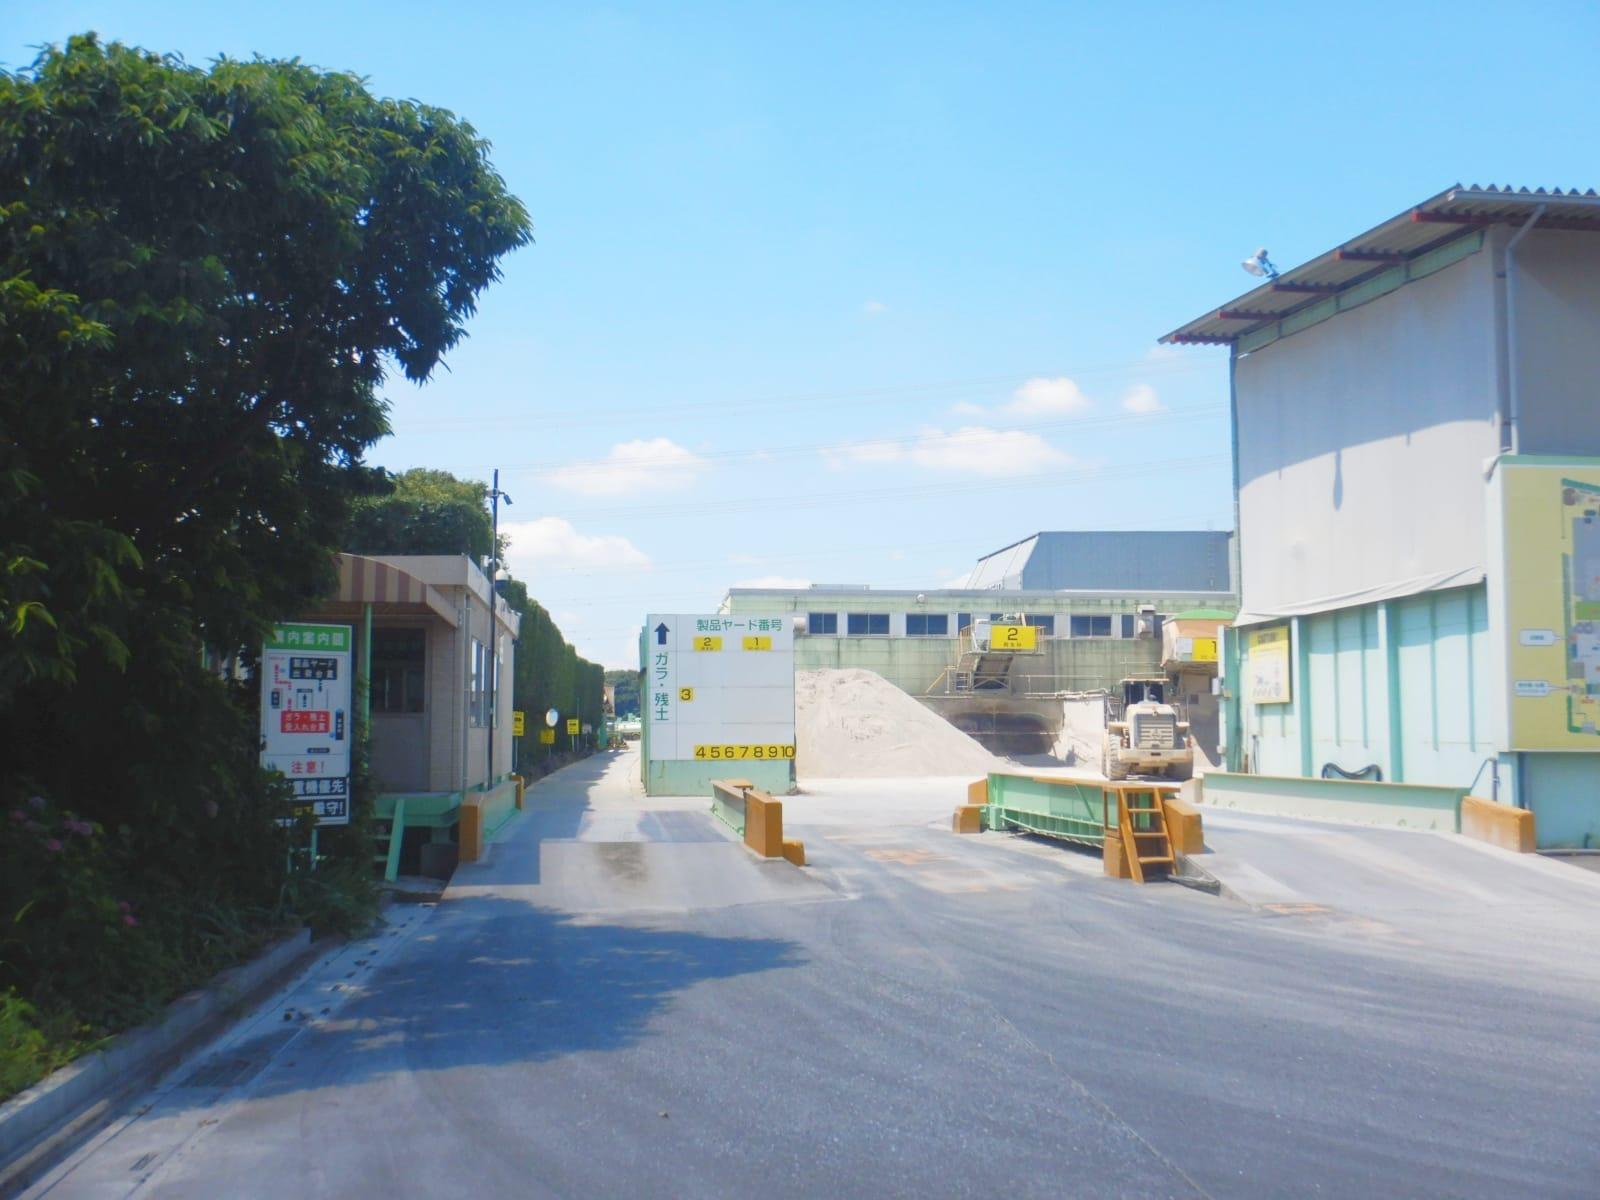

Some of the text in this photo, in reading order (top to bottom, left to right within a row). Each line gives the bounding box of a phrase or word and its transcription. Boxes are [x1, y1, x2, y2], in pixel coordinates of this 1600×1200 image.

[696, 619, 783, 631] 製品ヤード番号
[1007, 627, 1018, 641] 2
[703, 637, 712, 646] 2
[655, 652, 669, 721] ガラ・残土
[681, 689, 691, 701] 3
[696, 747, 795, 758] 4 5 6 7 8 9 10
